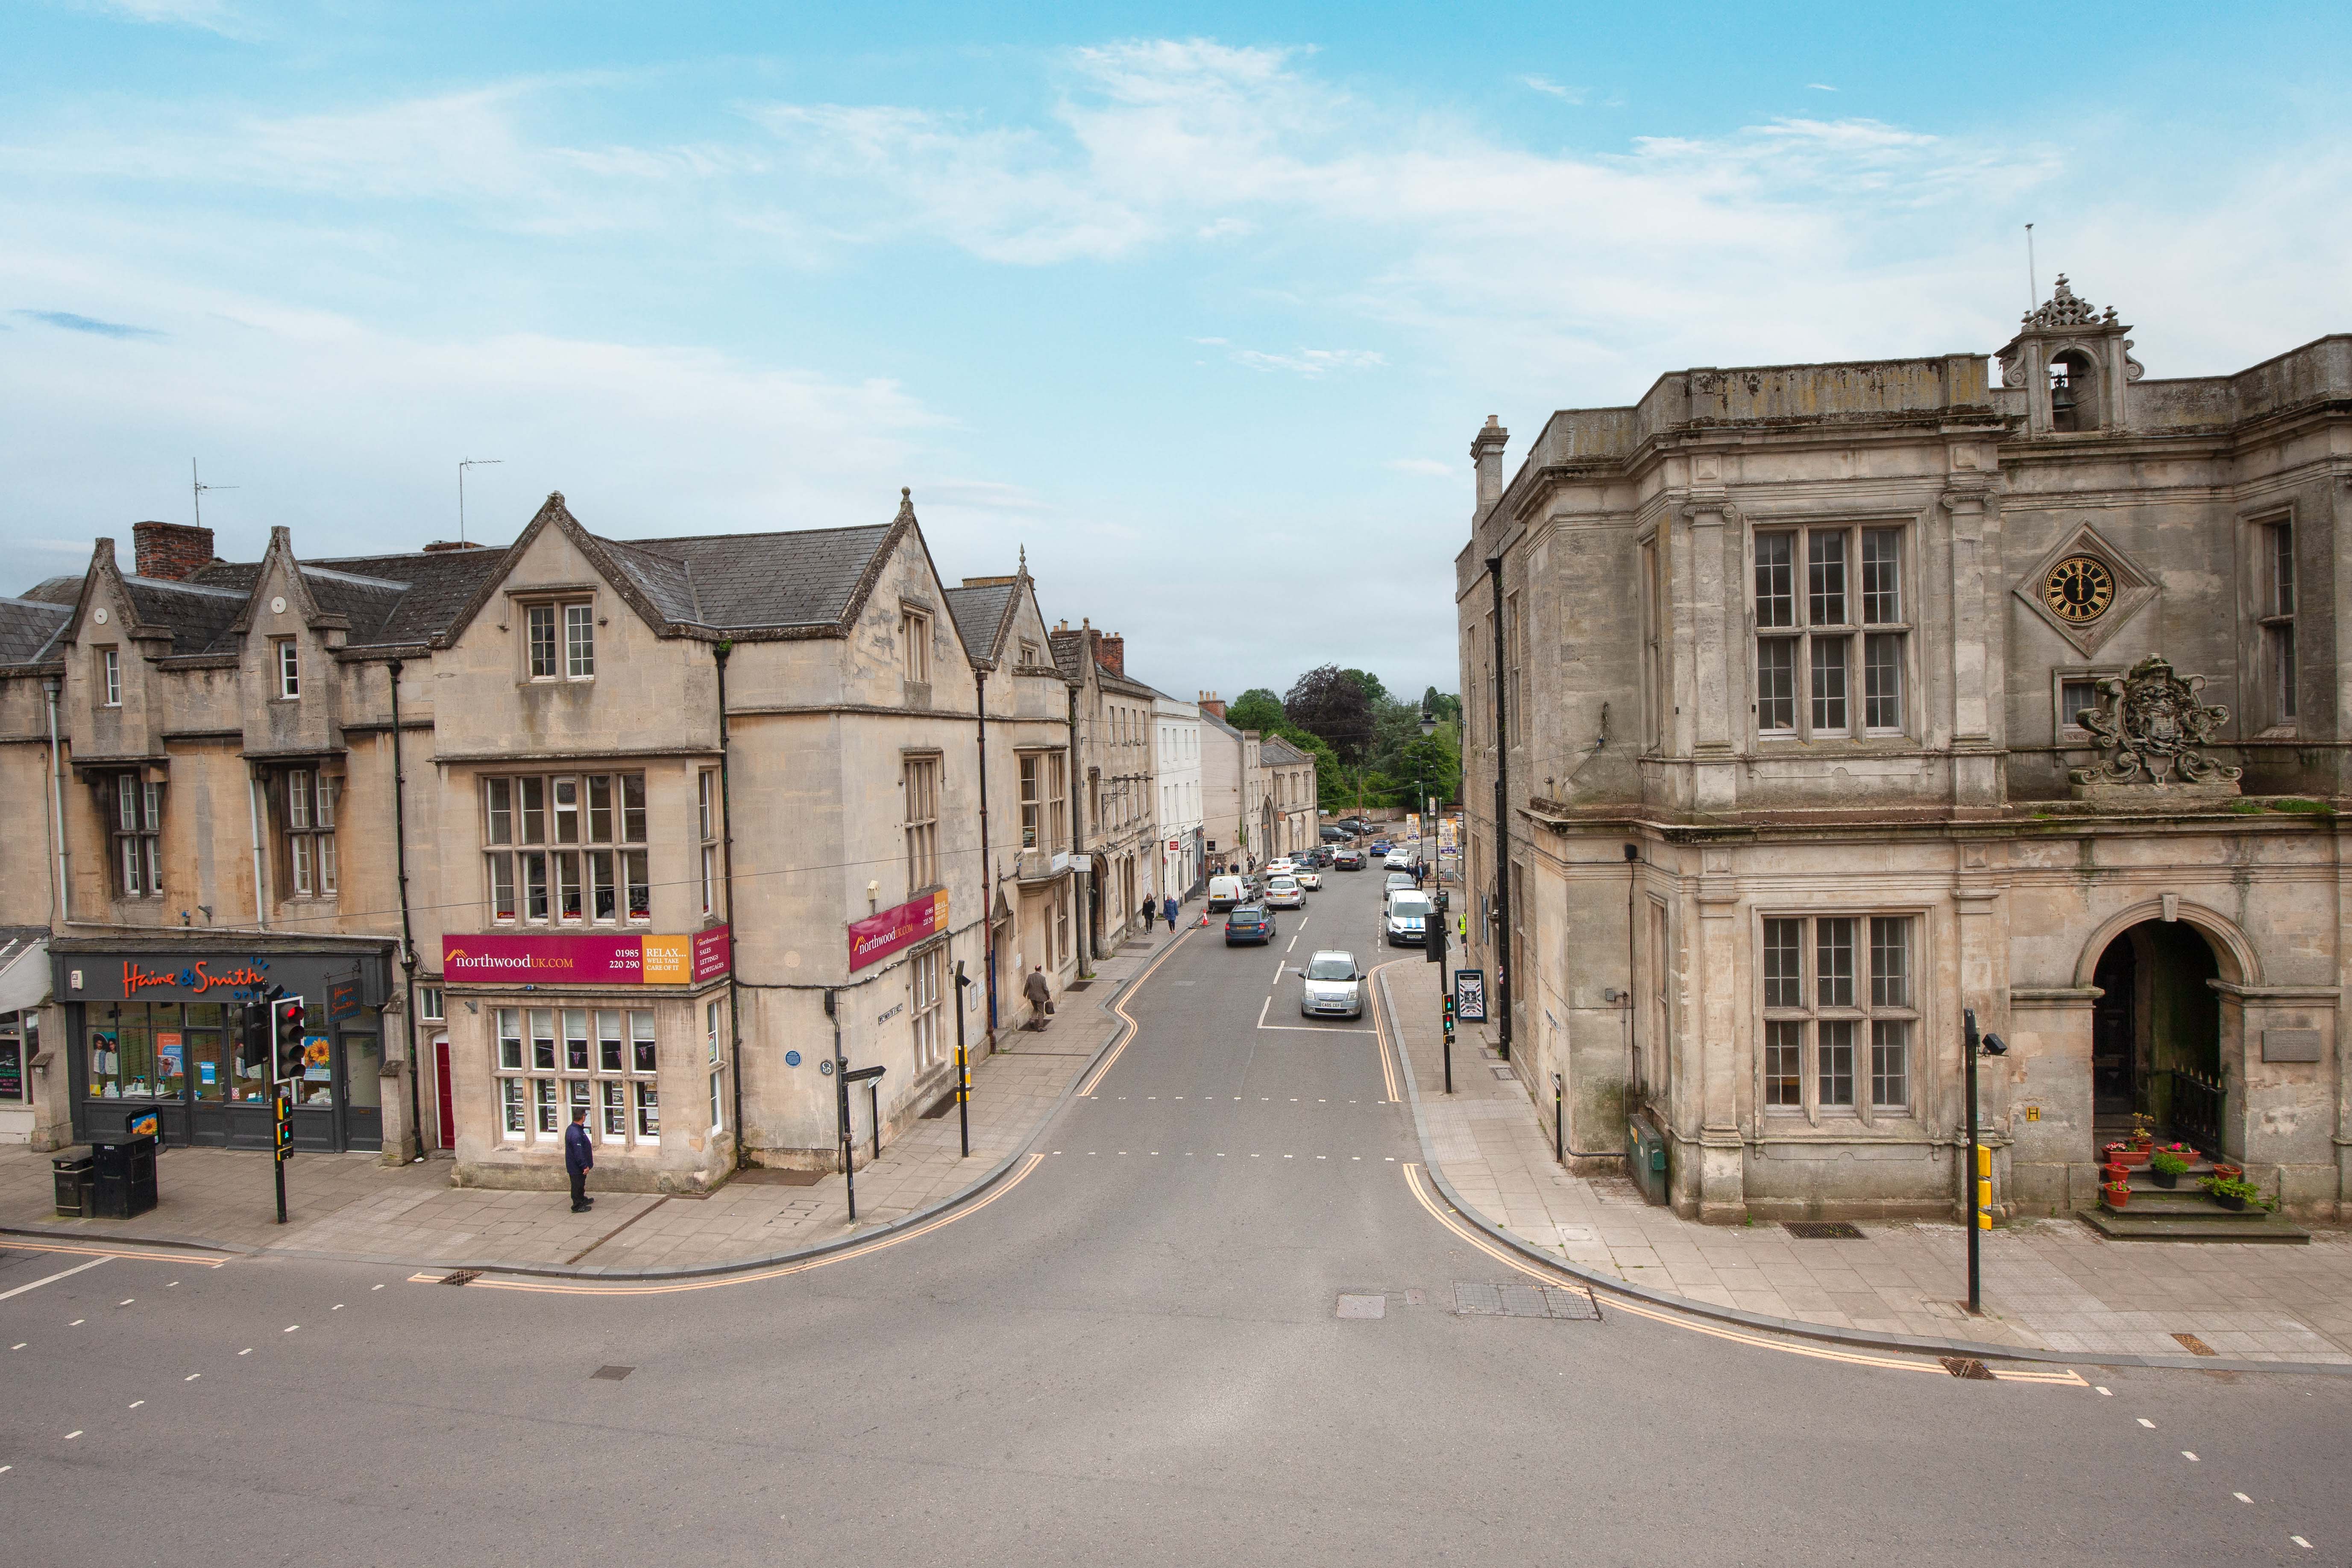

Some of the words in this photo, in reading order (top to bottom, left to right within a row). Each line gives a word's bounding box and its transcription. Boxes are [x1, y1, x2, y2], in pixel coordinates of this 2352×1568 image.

[925, 906, 933, 916] 01985
[859, 923, 913, 955] northwoodUK.COM
[615, 949, 639, 957] 01985
[646, 948, 686, 957] RELAX...
[699, 947, 711, 955] SALES
[456, 954, 573, 967] northwoodUK.COM
[700, 954, 719, 965] LETTINGS
[700, 962, 724, 976] MORTGAGES
[123, 961, 176, 998] Haine
[179, 968, 195, 986] &
[193, 961, 264, 993] Smith
[2028, 1108, 2038, 1119] H
